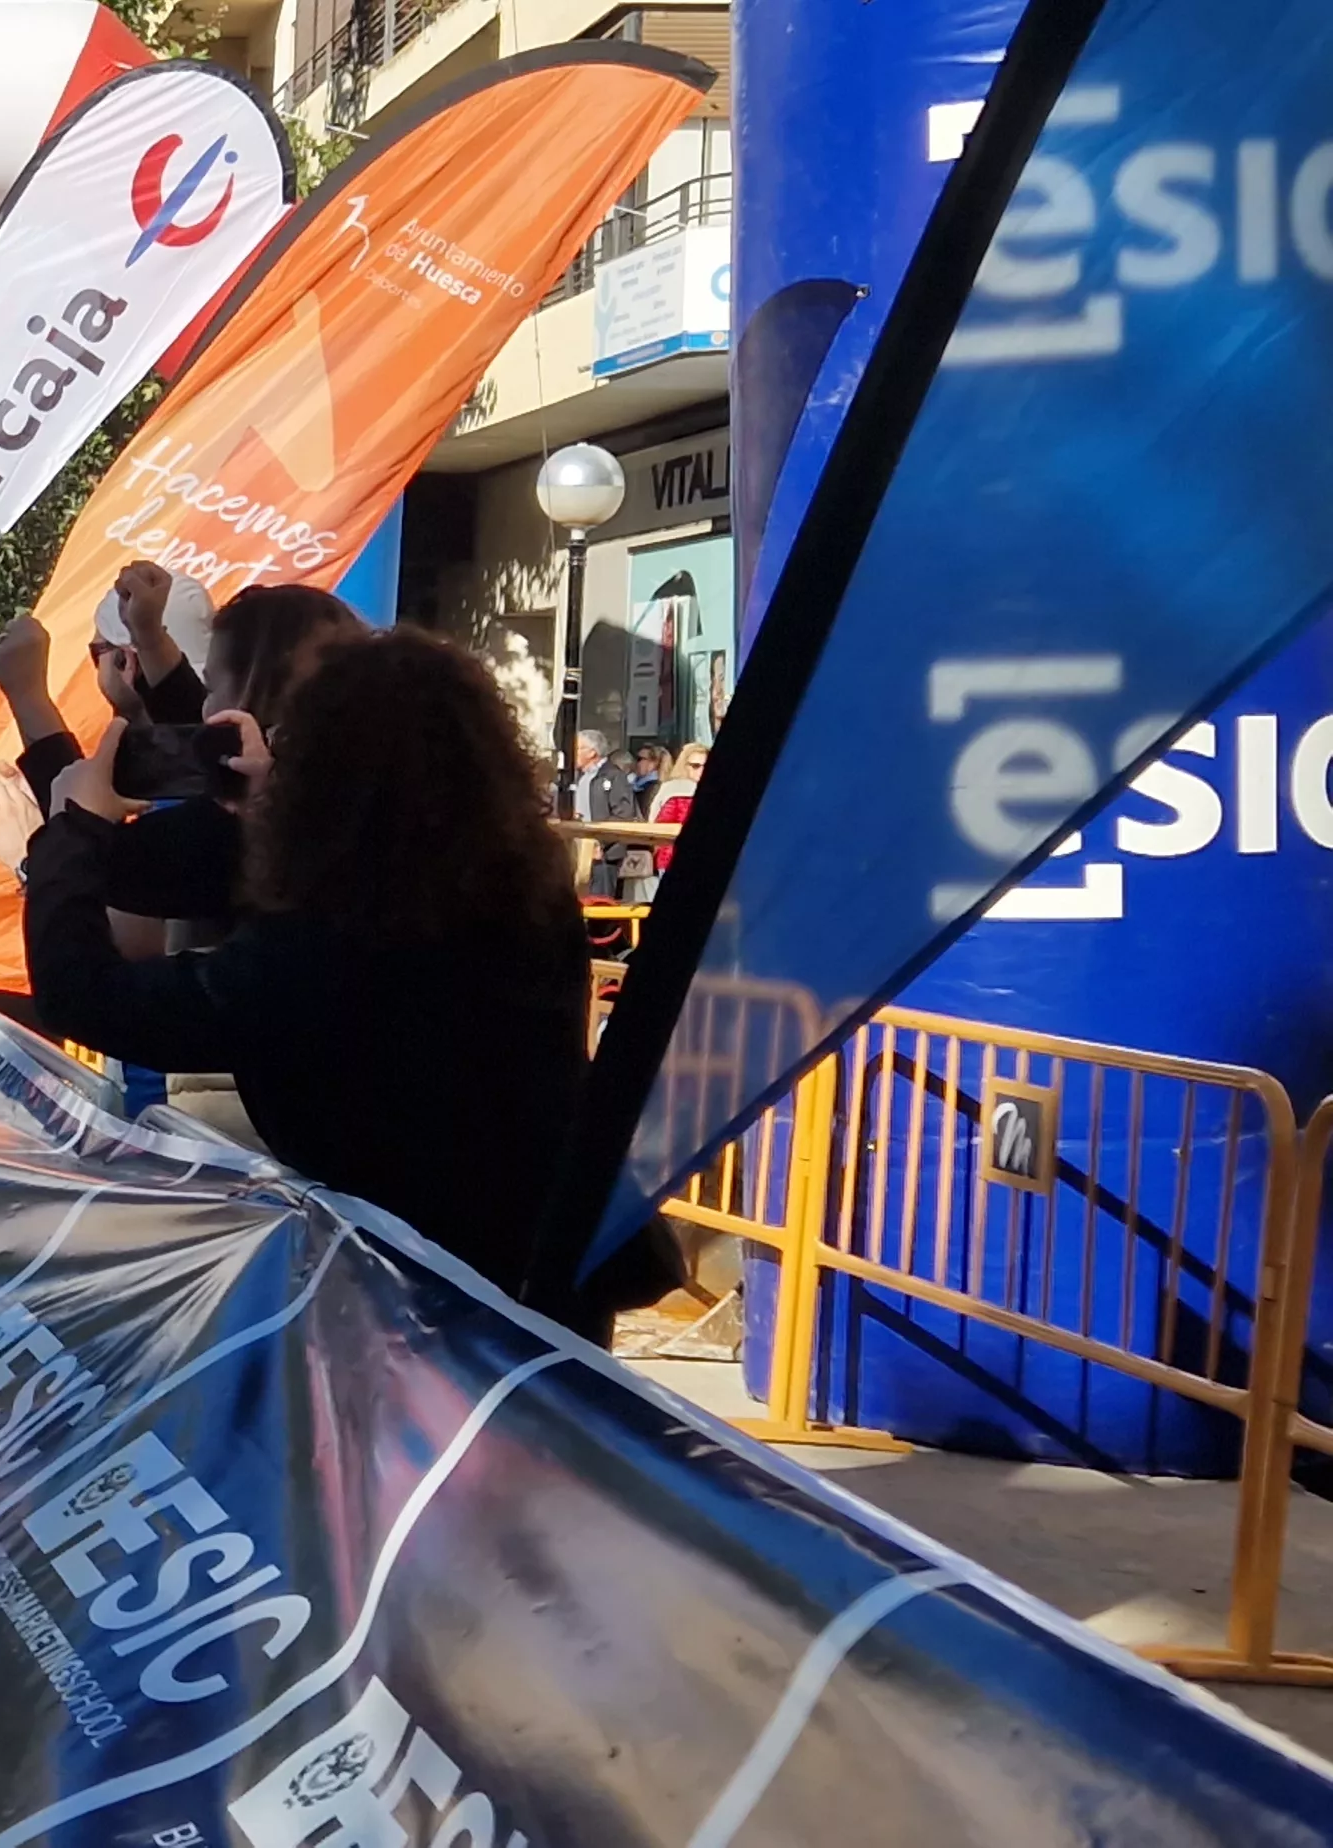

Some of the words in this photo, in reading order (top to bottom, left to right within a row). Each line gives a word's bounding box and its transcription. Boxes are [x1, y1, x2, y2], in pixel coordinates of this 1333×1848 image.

[385, 240, 408, 263] de
[408, 251, 482, 305] Huesca
[400, 217, 525, 298] Ayuntamiento
[125, 435, 337, 569] Hacemos
[651, 452, 731, 510] VITAL
[105, 496, 282, 594] deport
[49, 1475, 312, 1703] ESIC
